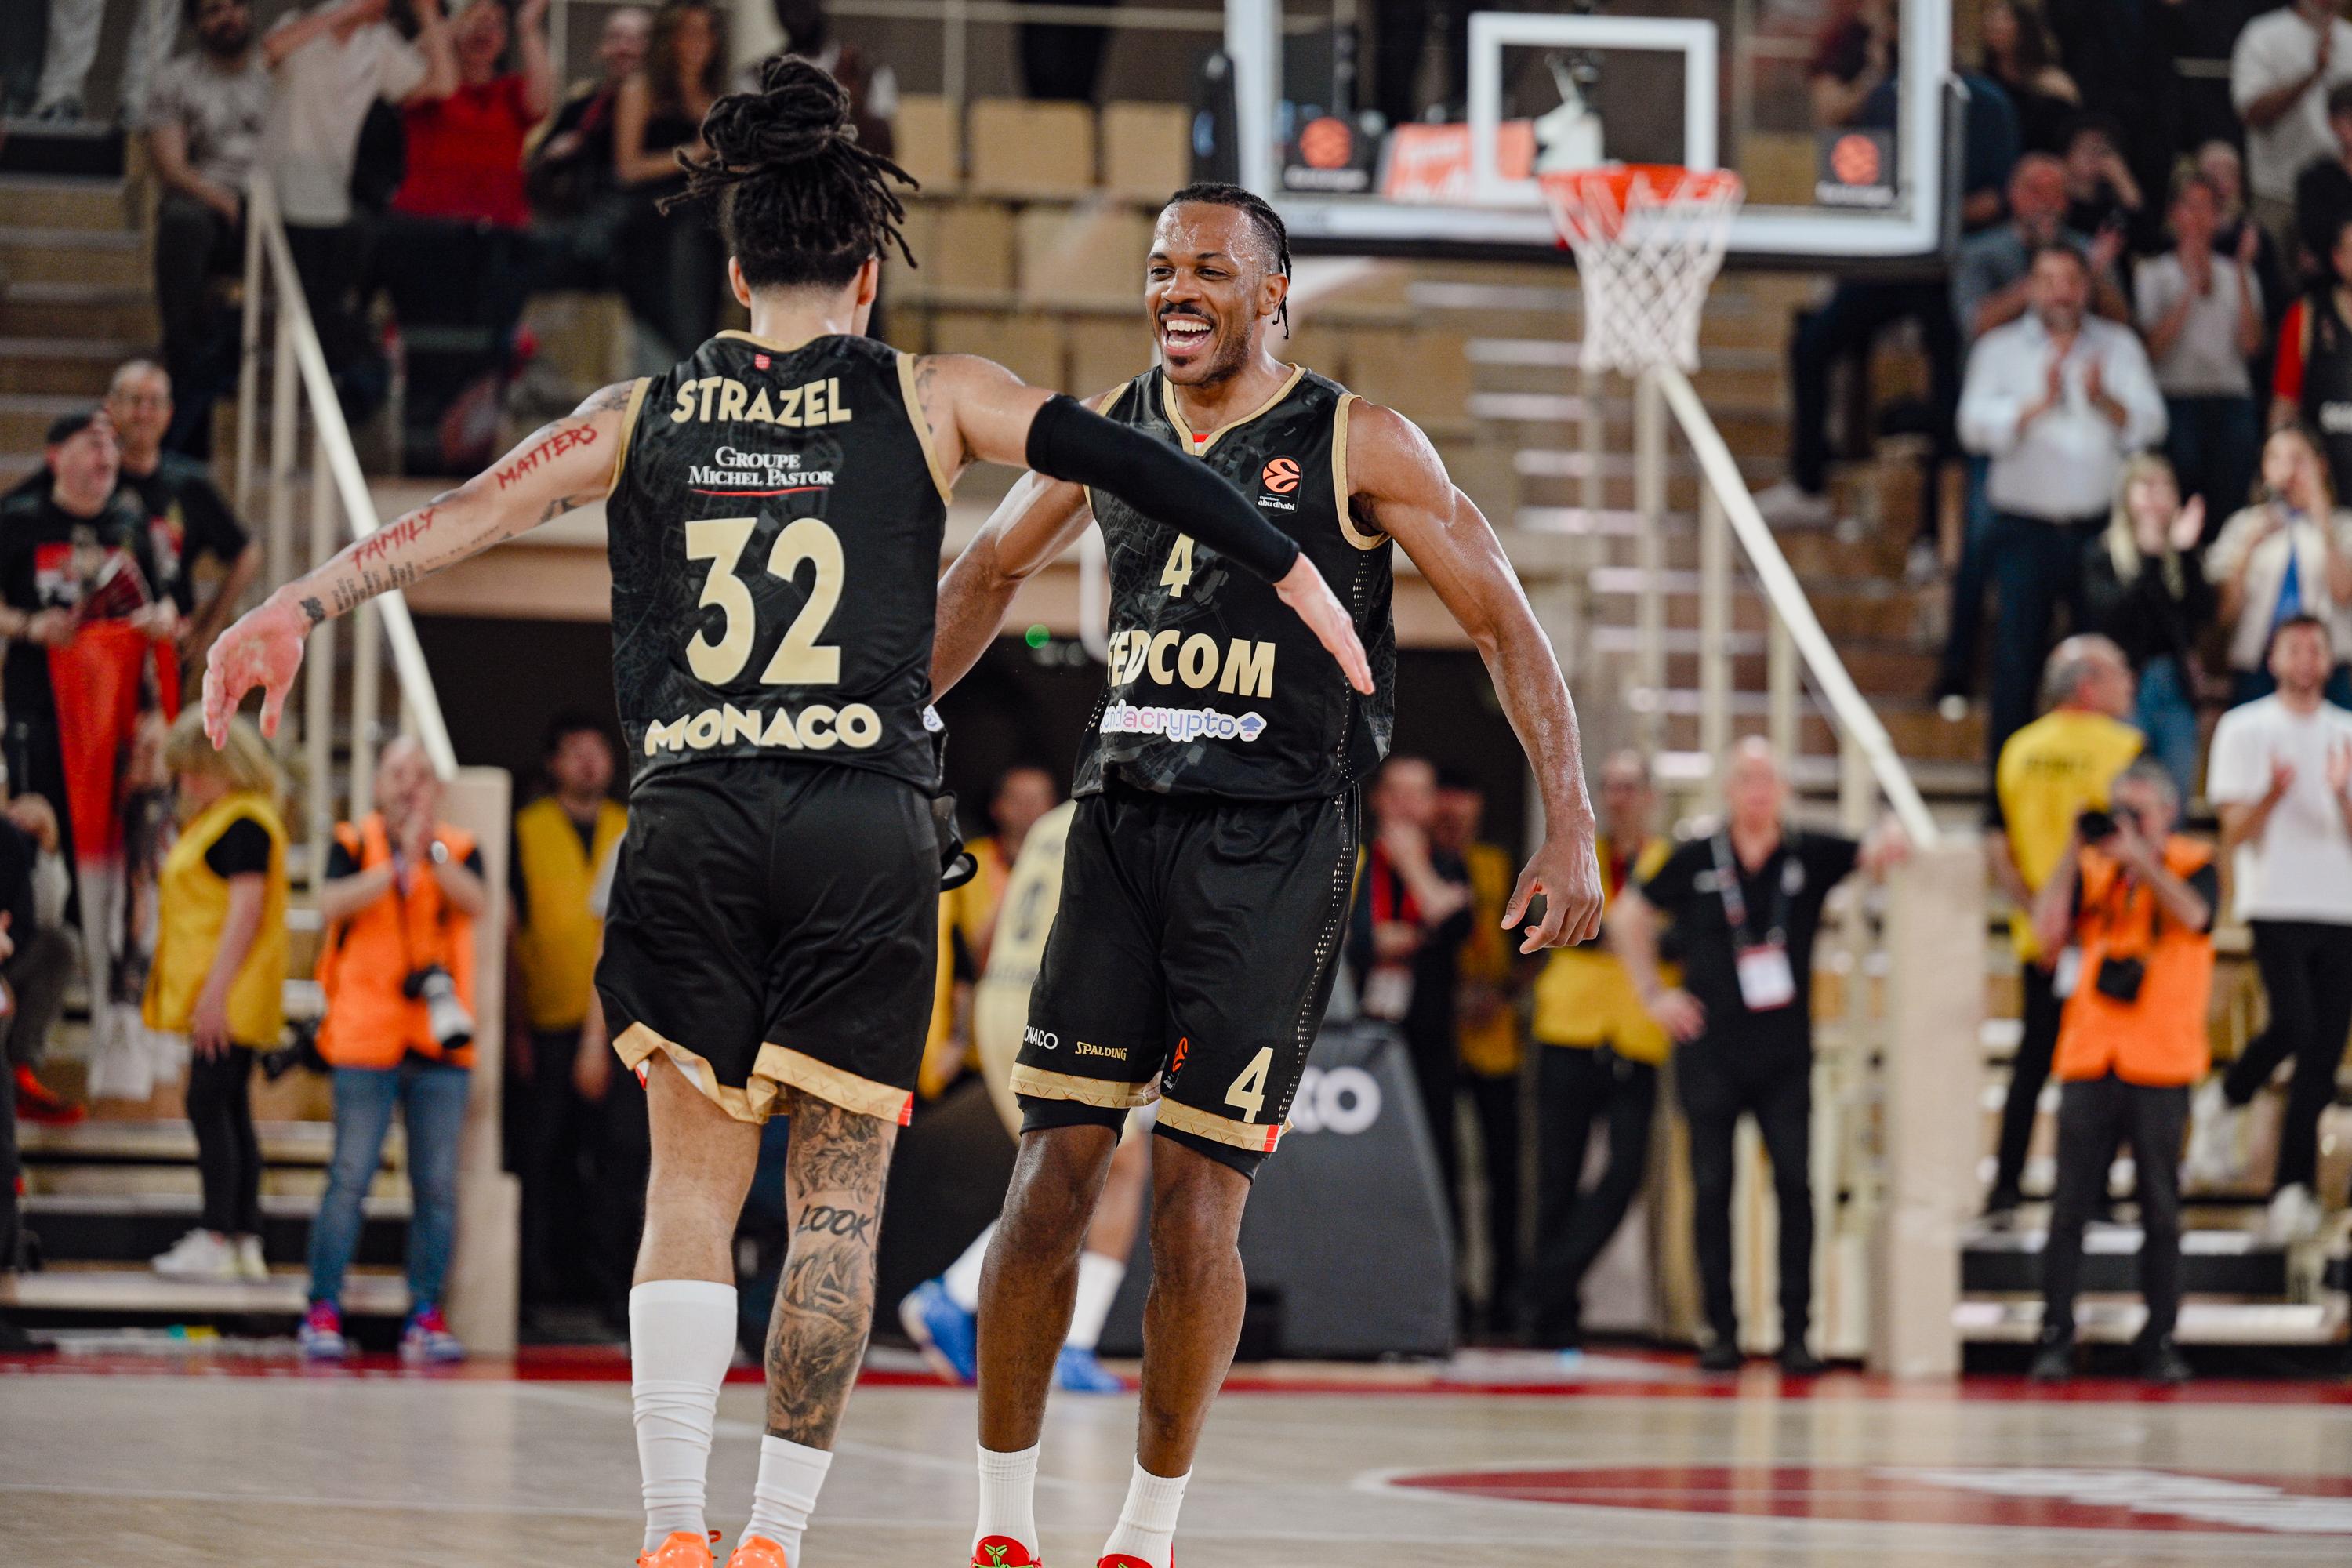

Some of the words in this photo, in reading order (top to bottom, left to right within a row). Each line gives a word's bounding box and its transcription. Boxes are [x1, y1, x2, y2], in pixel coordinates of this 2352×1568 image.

[670, 376, 852, 427] STRAZEL
[688, 466, 764, 486] MICHEL
[766, 469, 834, 486] PASTOR
[715, 446, 801, 469] GROUPE
[352, 506, 436, 572] FAMILY
[495, 423, 598, 491] MATTERS
[1159, 532, 1195, 598] 4
[684, 517, 845, 686] 32
[644, 702, 883, 757] MONACO
[1100, 704, 1235, 739] ondacrypto
[1024, 1025, 1058, 1050] ONACO
[1074, 1040, 1127, 1062] SPALDING
[1224, 1046, 1274, 1123] 4
[795, 1203, 873, 1247] LOOK
